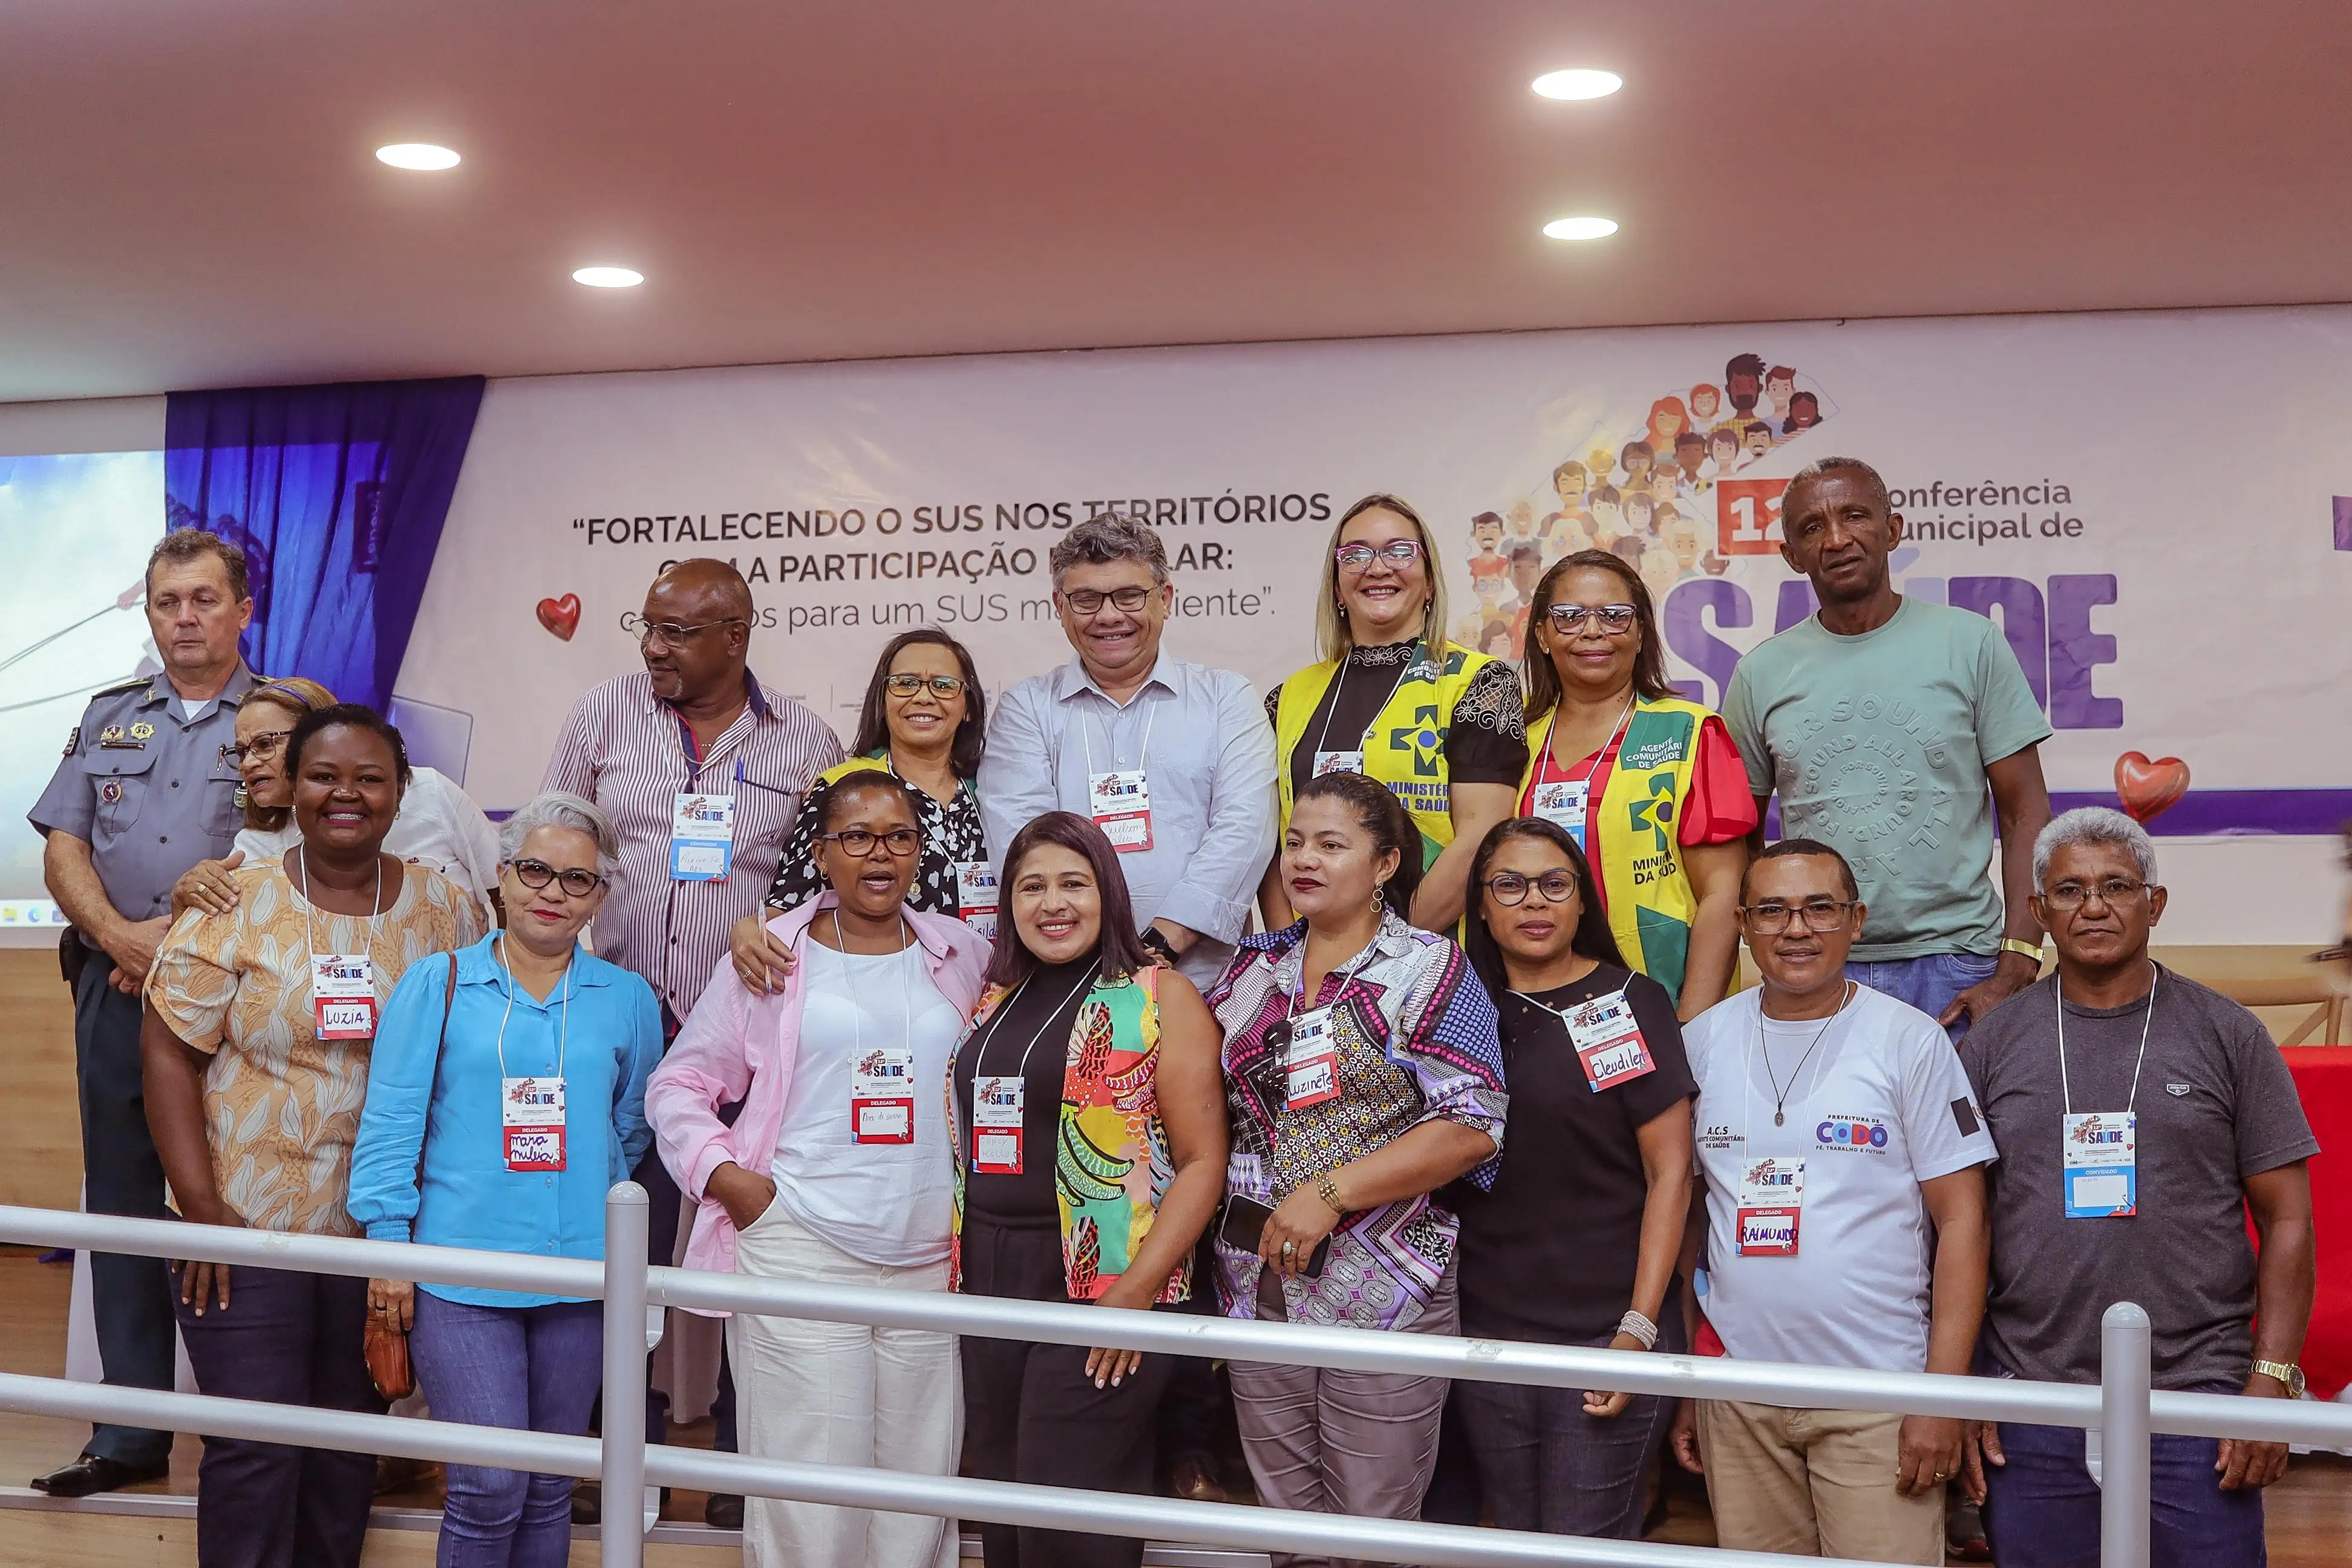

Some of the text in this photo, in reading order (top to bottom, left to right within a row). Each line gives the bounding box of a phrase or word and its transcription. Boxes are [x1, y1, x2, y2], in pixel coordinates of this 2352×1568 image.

[1887, 478, 2071, 509] onferência
[877, 507, 902, 535] O
[913, 504, 984, 534] SUS
[995, 501, 1073, 531] NOS
[1083, 489, 1331, 526] TERRITÓRIOS
[1901, 512, 2084, 546] unicipal de
[748, 557, 770, 584] A
[780, 543, 1037, 584] PARTICIPAÇÃO
[788, 606, 855, 635] para
[871, 602, 924, 626] um
[936, 594, 1008, 623] SUS
[1640, 736, 1674, 753] AGENTE
[1638, 760, 1651, 769] DE
[1805, 734, 1858, 794] SOUND
[1863, 734, 1907, 767] ALL
[1830, 694, 1950, 770] SOUND
[1907, 785, 1953, 851] ALL
[1635, 871, 1655, 885] DA
[1707, 1126, 1728, 1135] A.C.S
